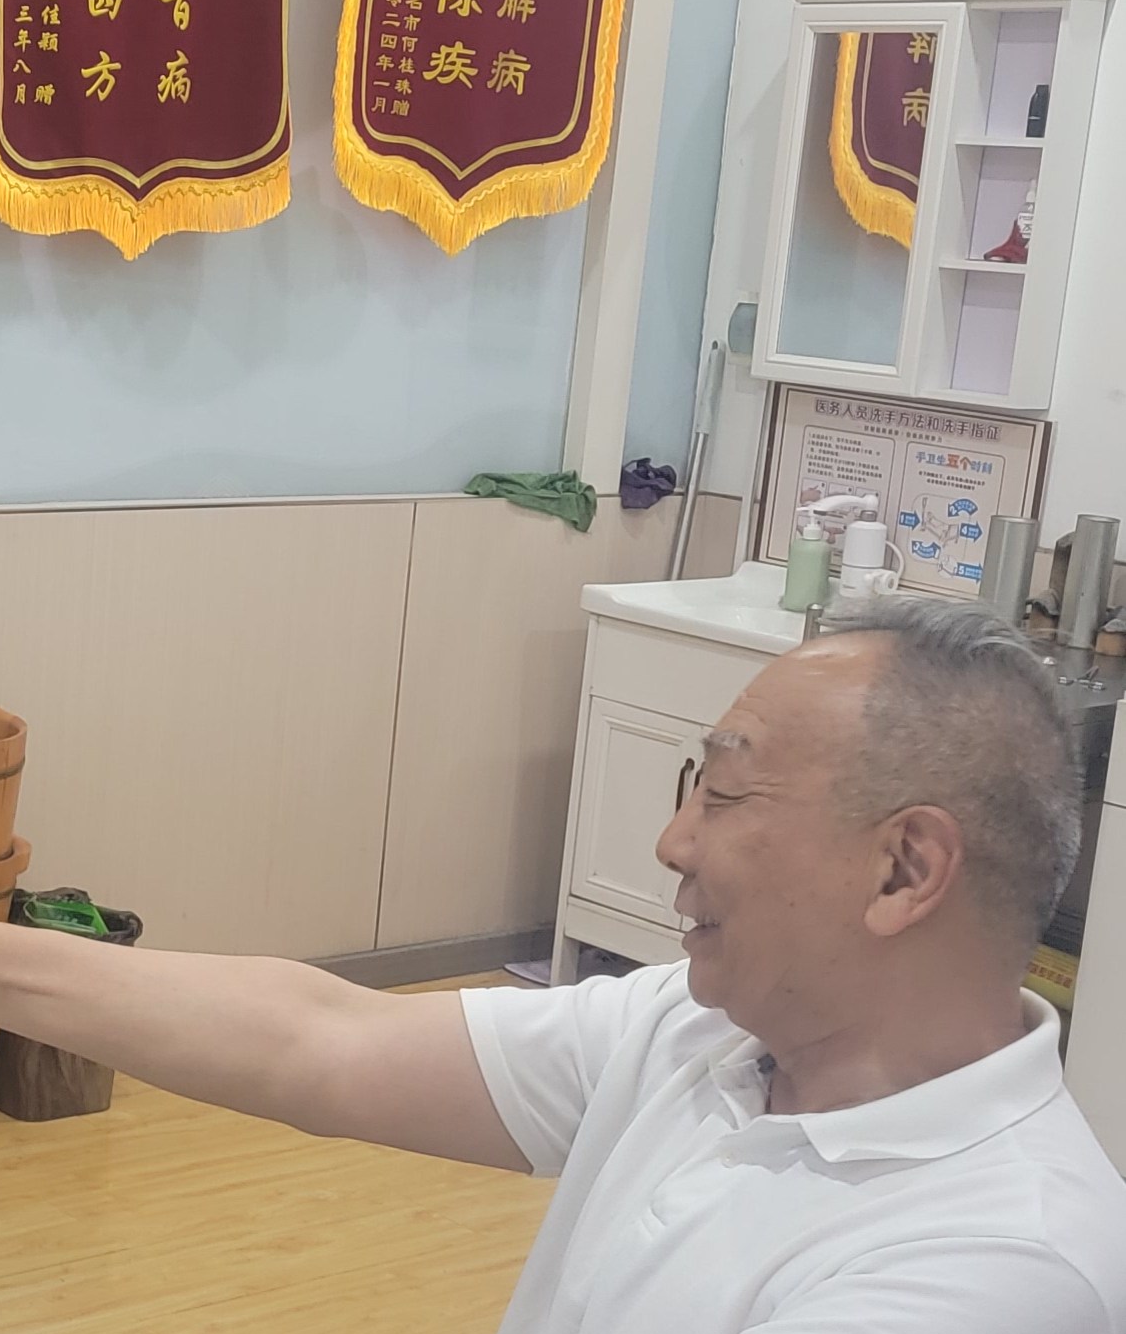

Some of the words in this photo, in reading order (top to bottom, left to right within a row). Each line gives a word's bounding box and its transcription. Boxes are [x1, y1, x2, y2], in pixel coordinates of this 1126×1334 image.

[814, 397, 1001, 441] 医务人员洗手方法和洗手指征
